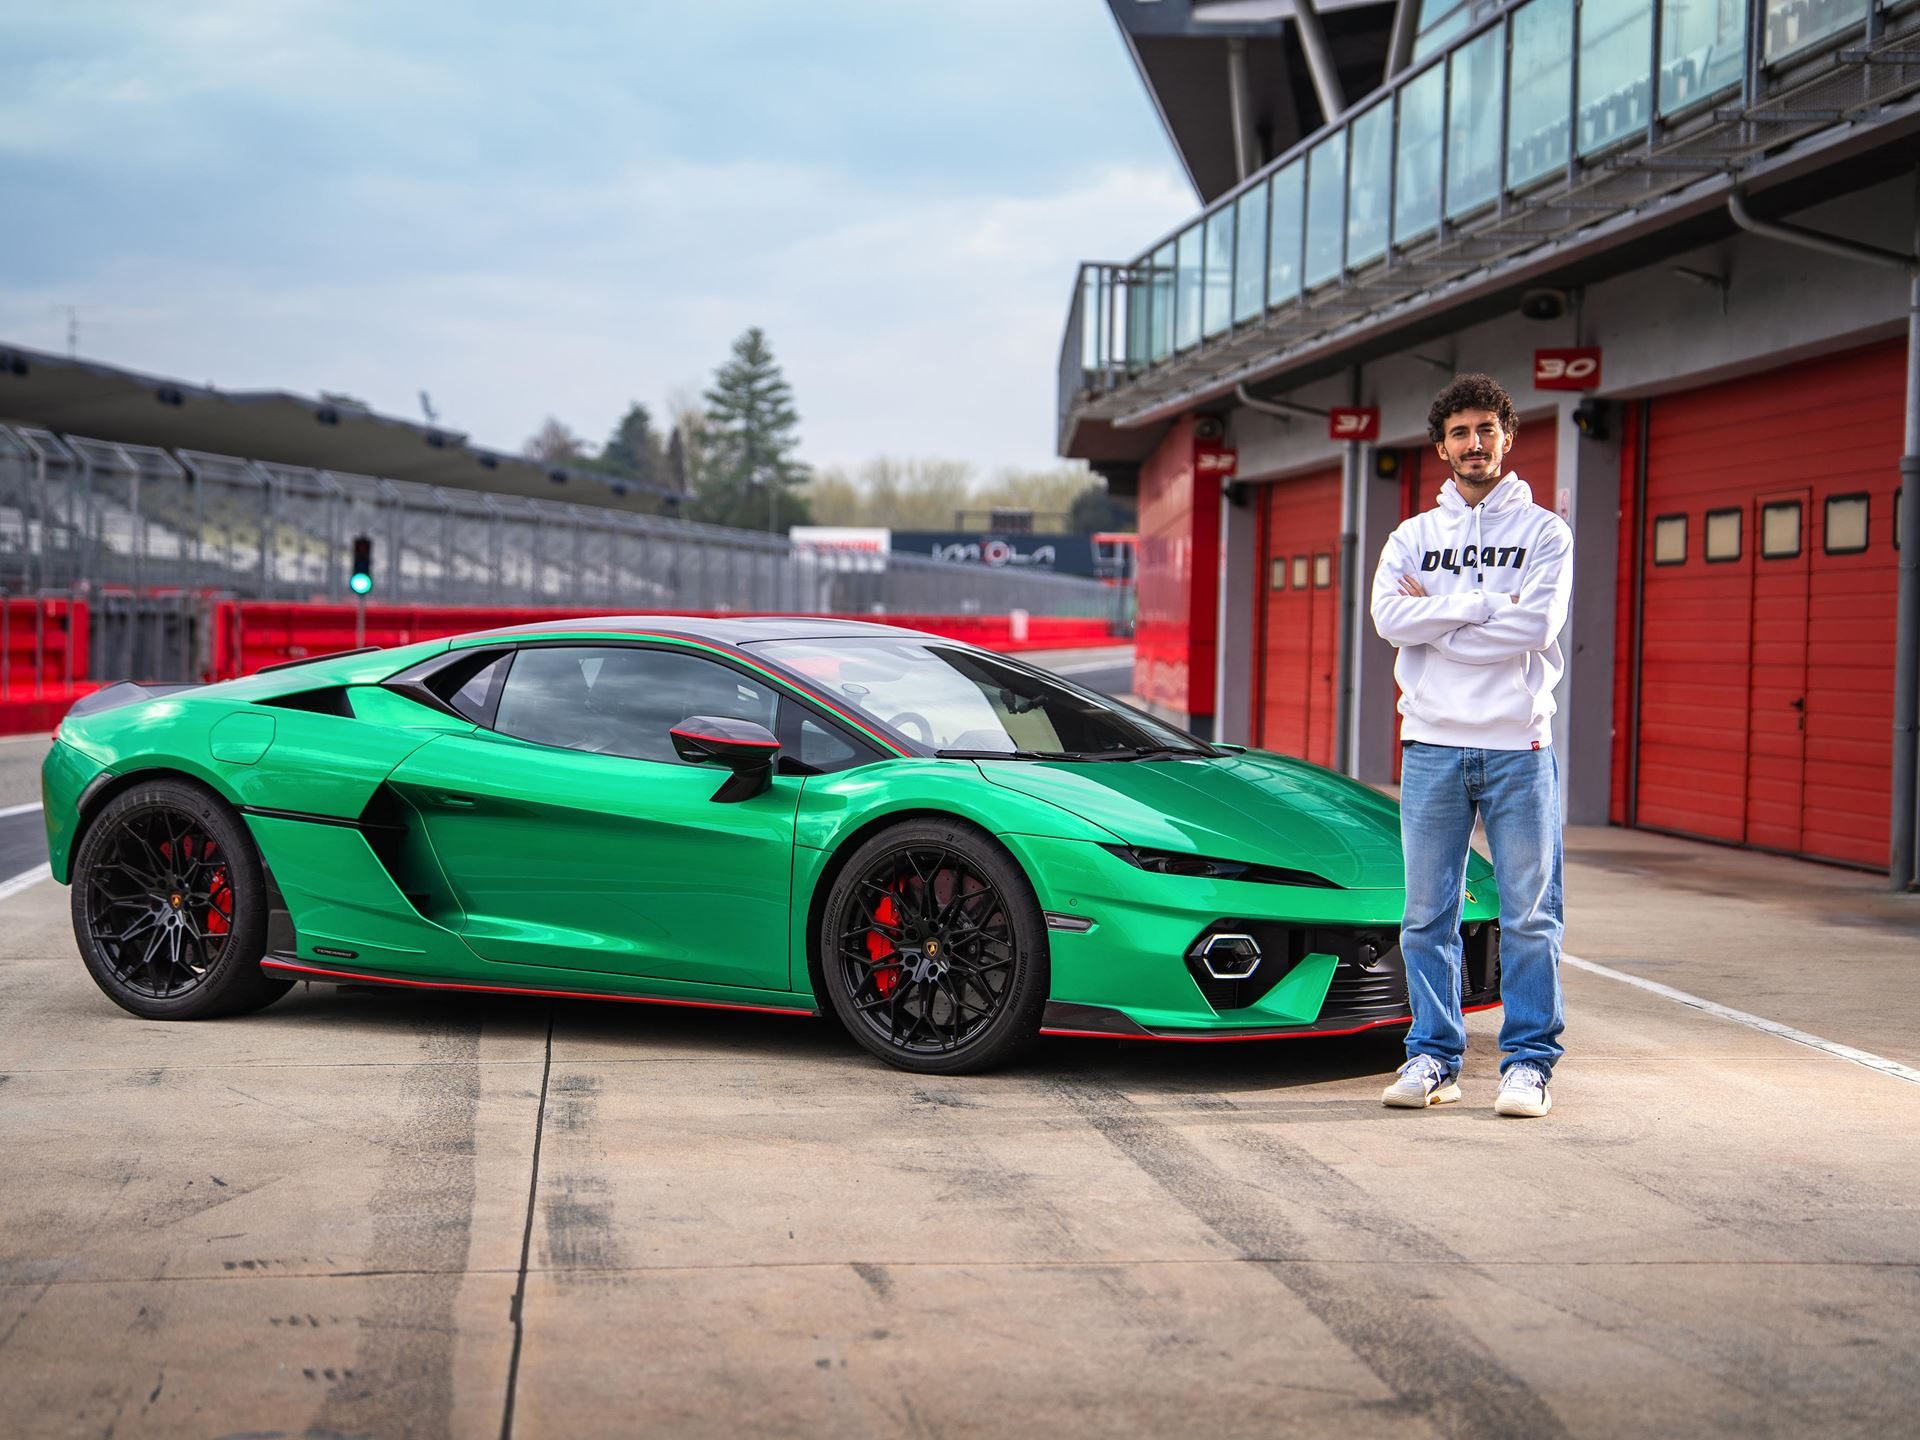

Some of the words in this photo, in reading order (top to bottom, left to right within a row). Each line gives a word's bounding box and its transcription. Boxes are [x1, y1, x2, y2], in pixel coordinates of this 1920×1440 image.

[1537, 358, 1597, 379] 30
[1334, 415, 1370, 432] 31
[1421, 545, 1527, 574] DUCATI
[1008, 951, 1029, 1013] BRIDGESTONE
